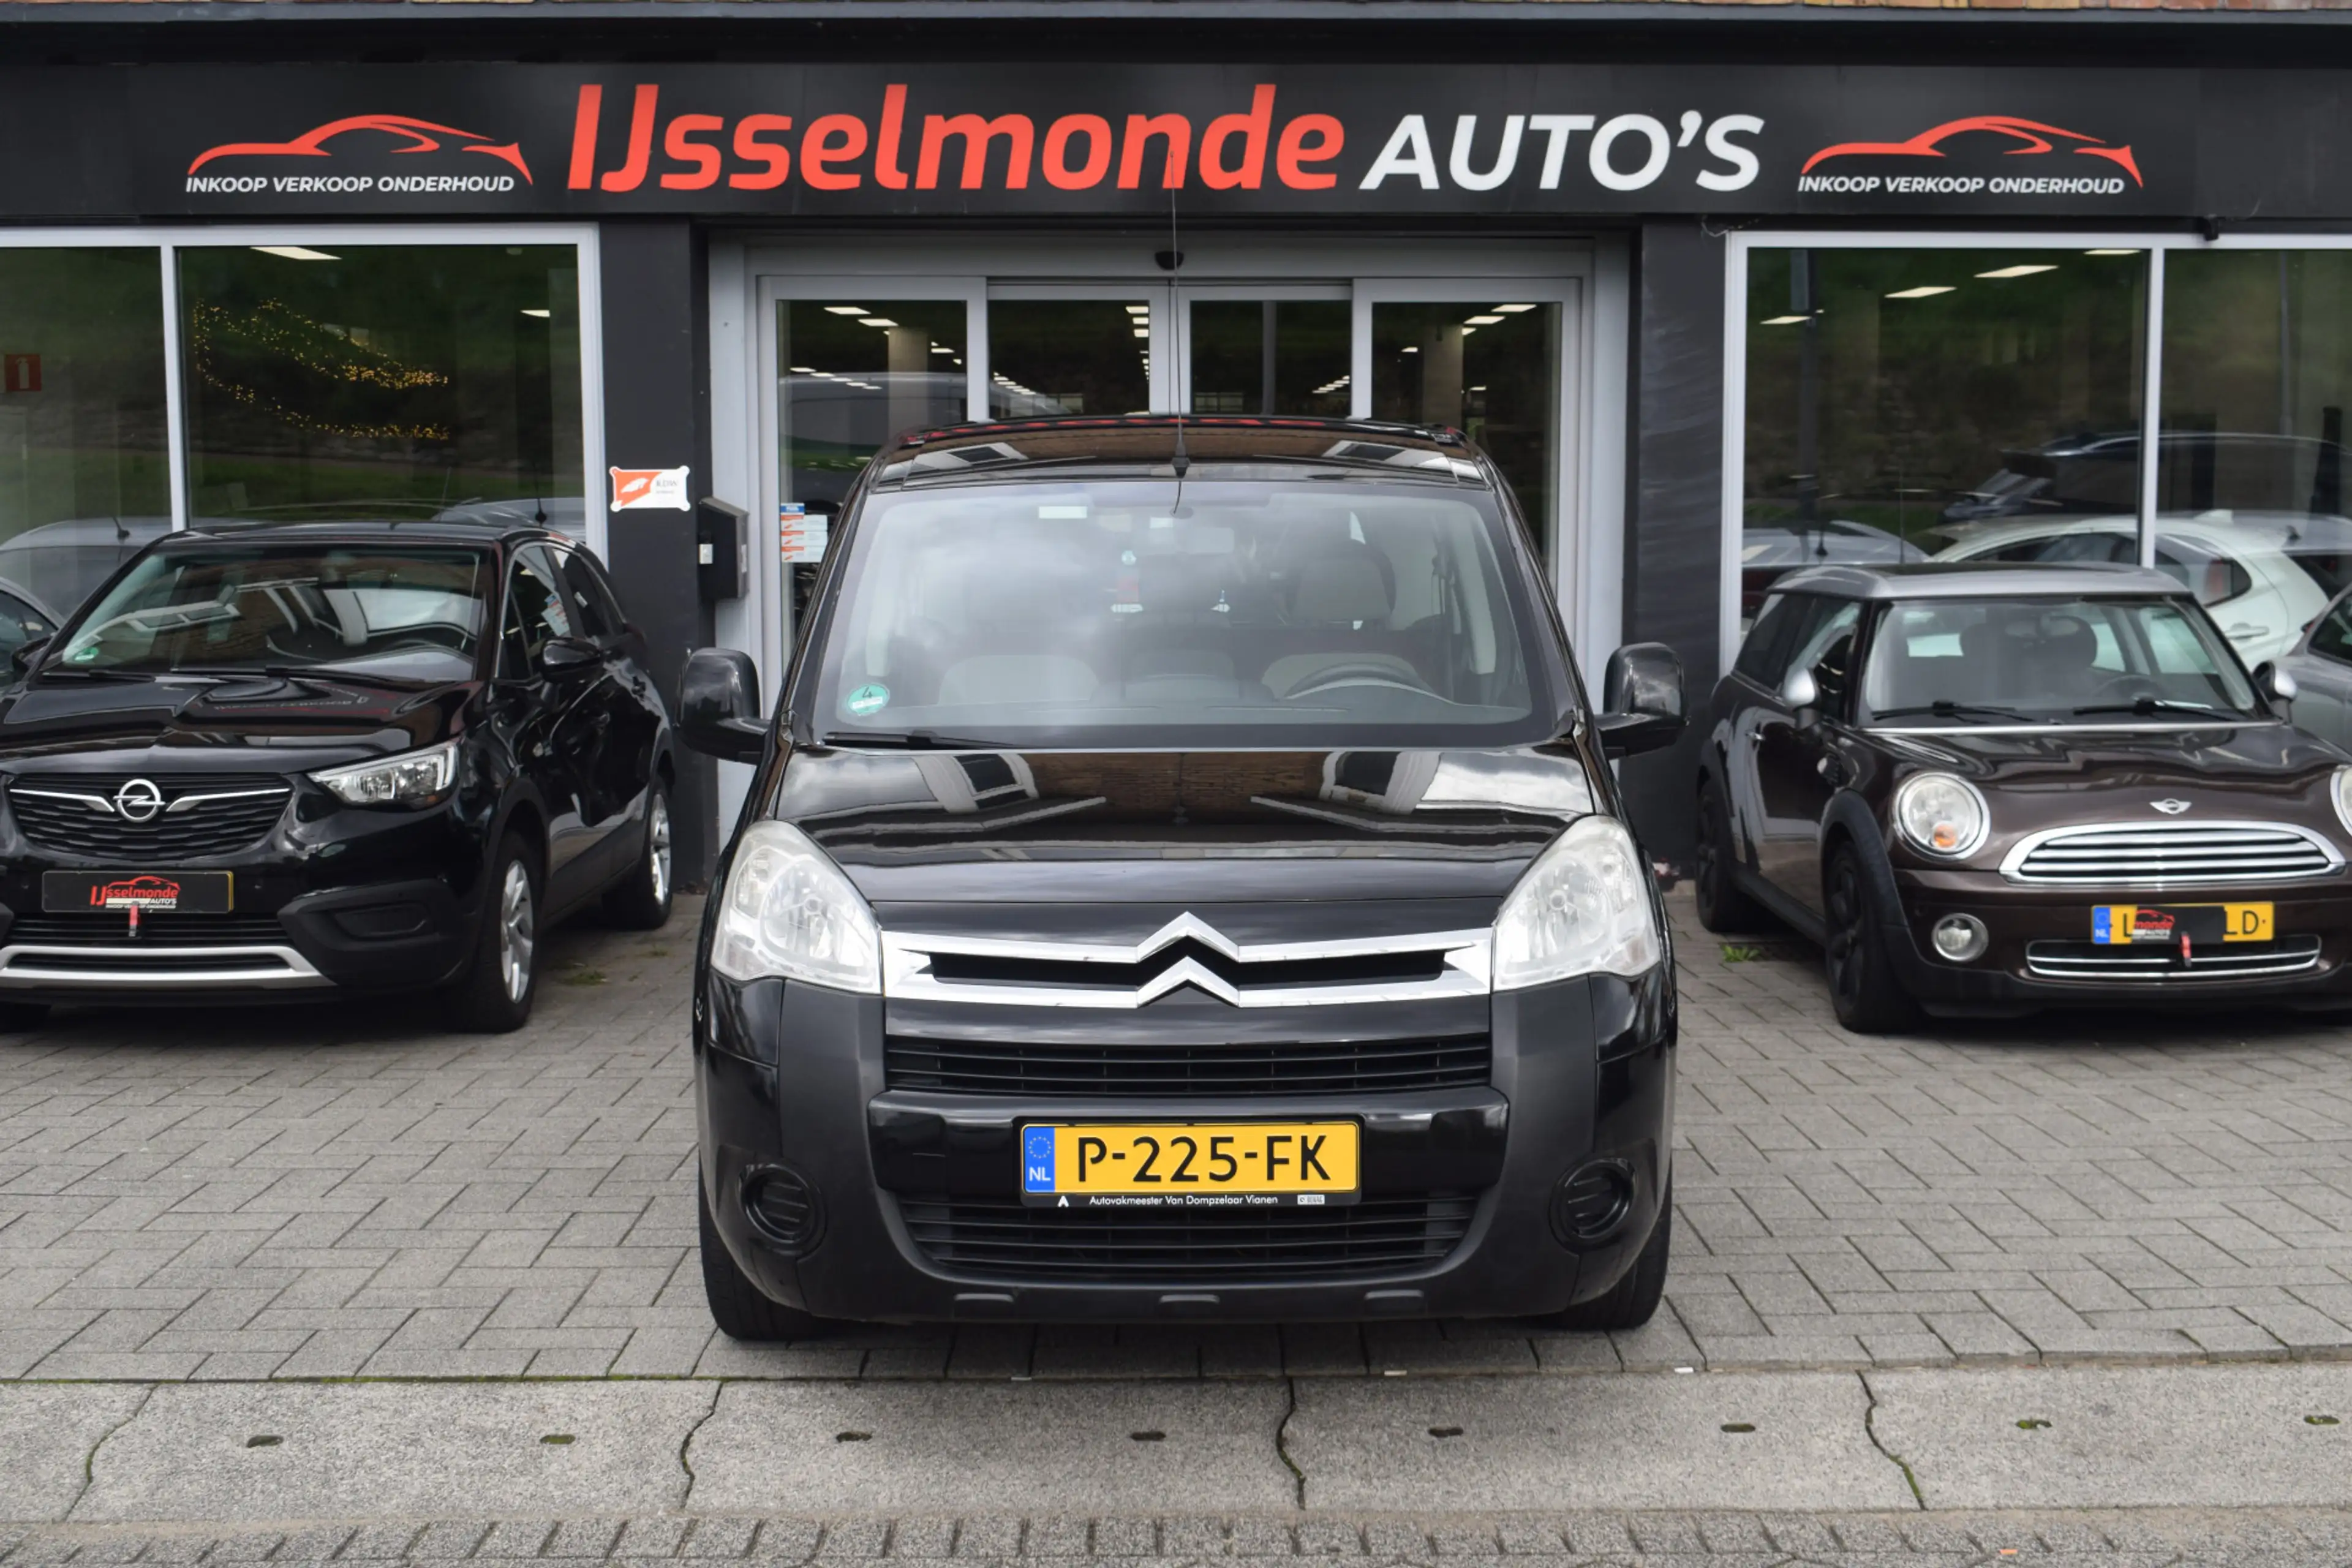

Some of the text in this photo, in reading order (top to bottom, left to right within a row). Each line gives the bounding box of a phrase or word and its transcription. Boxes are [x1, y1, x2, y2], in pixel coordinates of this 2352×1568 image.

[568, 85, 1764, 192] IJsselmonde AUTO'S
[186, 176, 514, 192] INKOOP VERKOOP ONDERHOUD
[1798, 176, 2125, 194] INKOOP VERKOOP ONDERHOUD
[862, 686, 873, 698] 4
[90, 886, 178, 906] IJsselmonde
[2095, 929, 2108, 938] NL
[1078, 1135, 1331, 1182] P-225-FK
[1029, 1167, 1050, 1181] NL
[1089, 1195, 1279, 1207] Autovakmeester Van Dompzelaar Vianen
